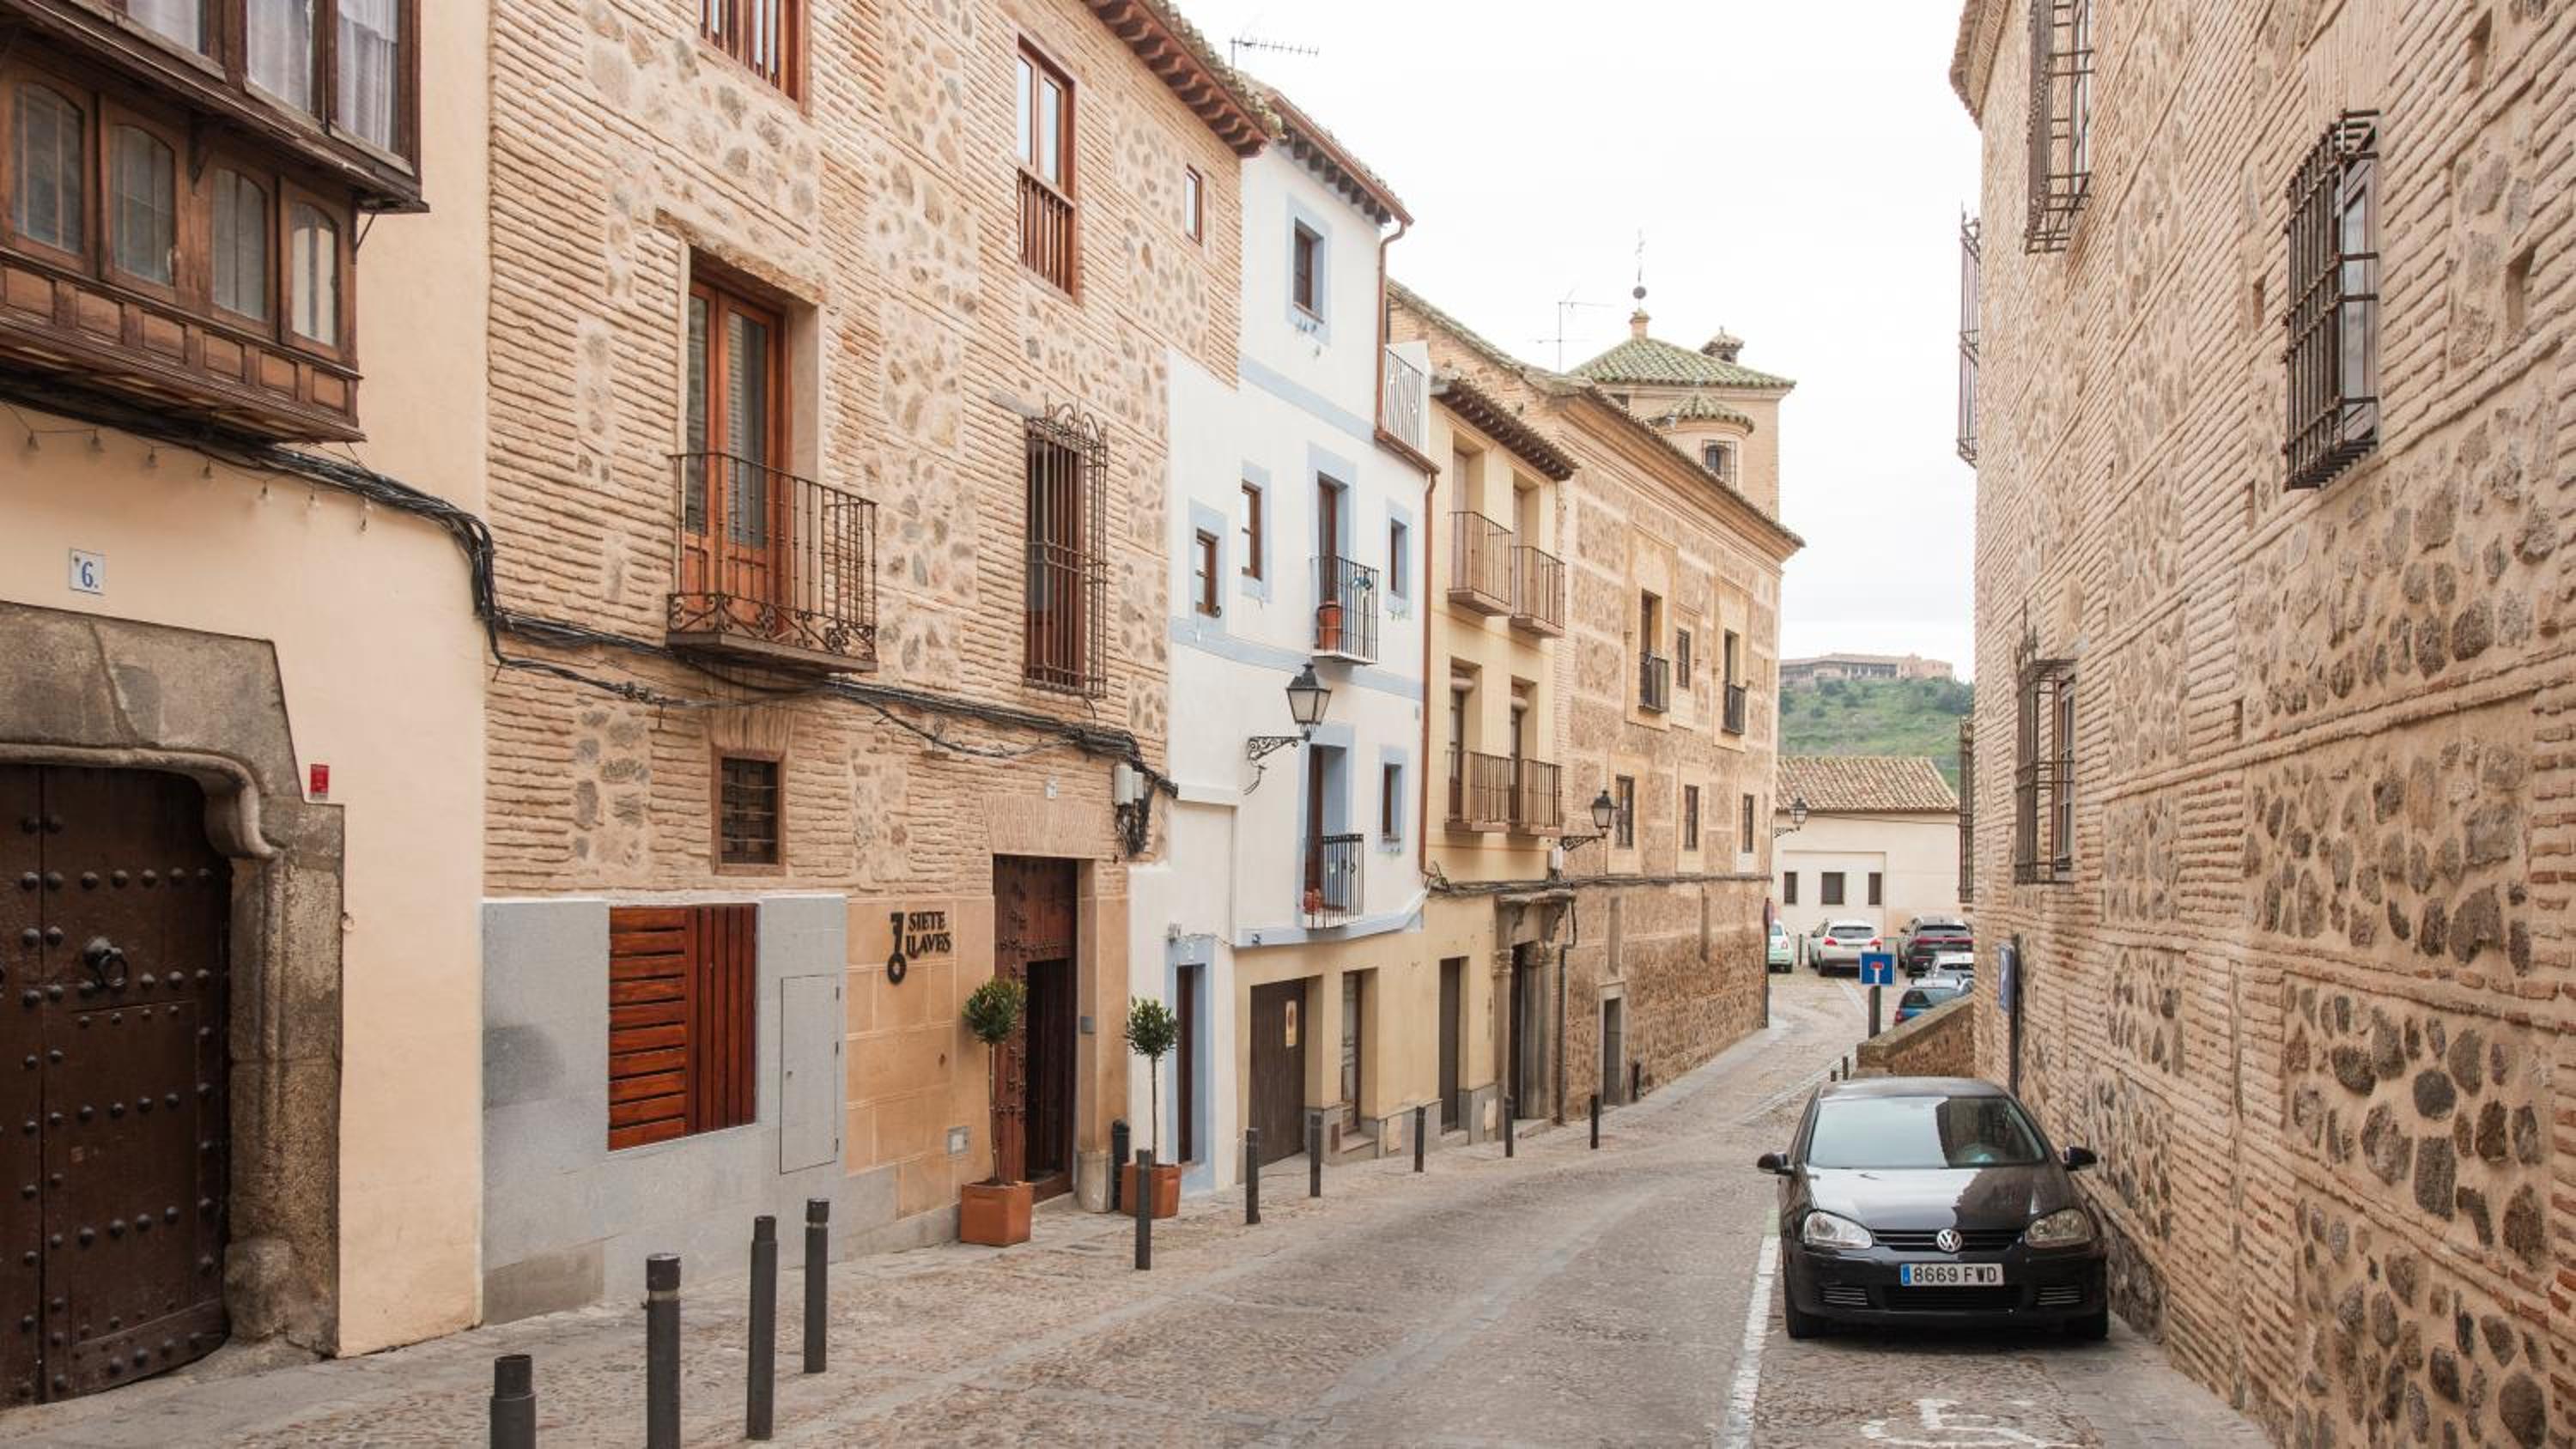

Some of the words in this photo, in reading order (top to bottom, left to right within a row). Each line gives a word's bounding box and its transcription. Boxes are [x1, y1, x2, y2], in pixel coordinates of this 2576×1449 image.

[908, 911, 945, 931] SIETE
[906, 932, 951, 960] LLAVES
[1914, 1266, 1958, 1283] 8669
[1964, 1266, 1996, 1283] FWD
